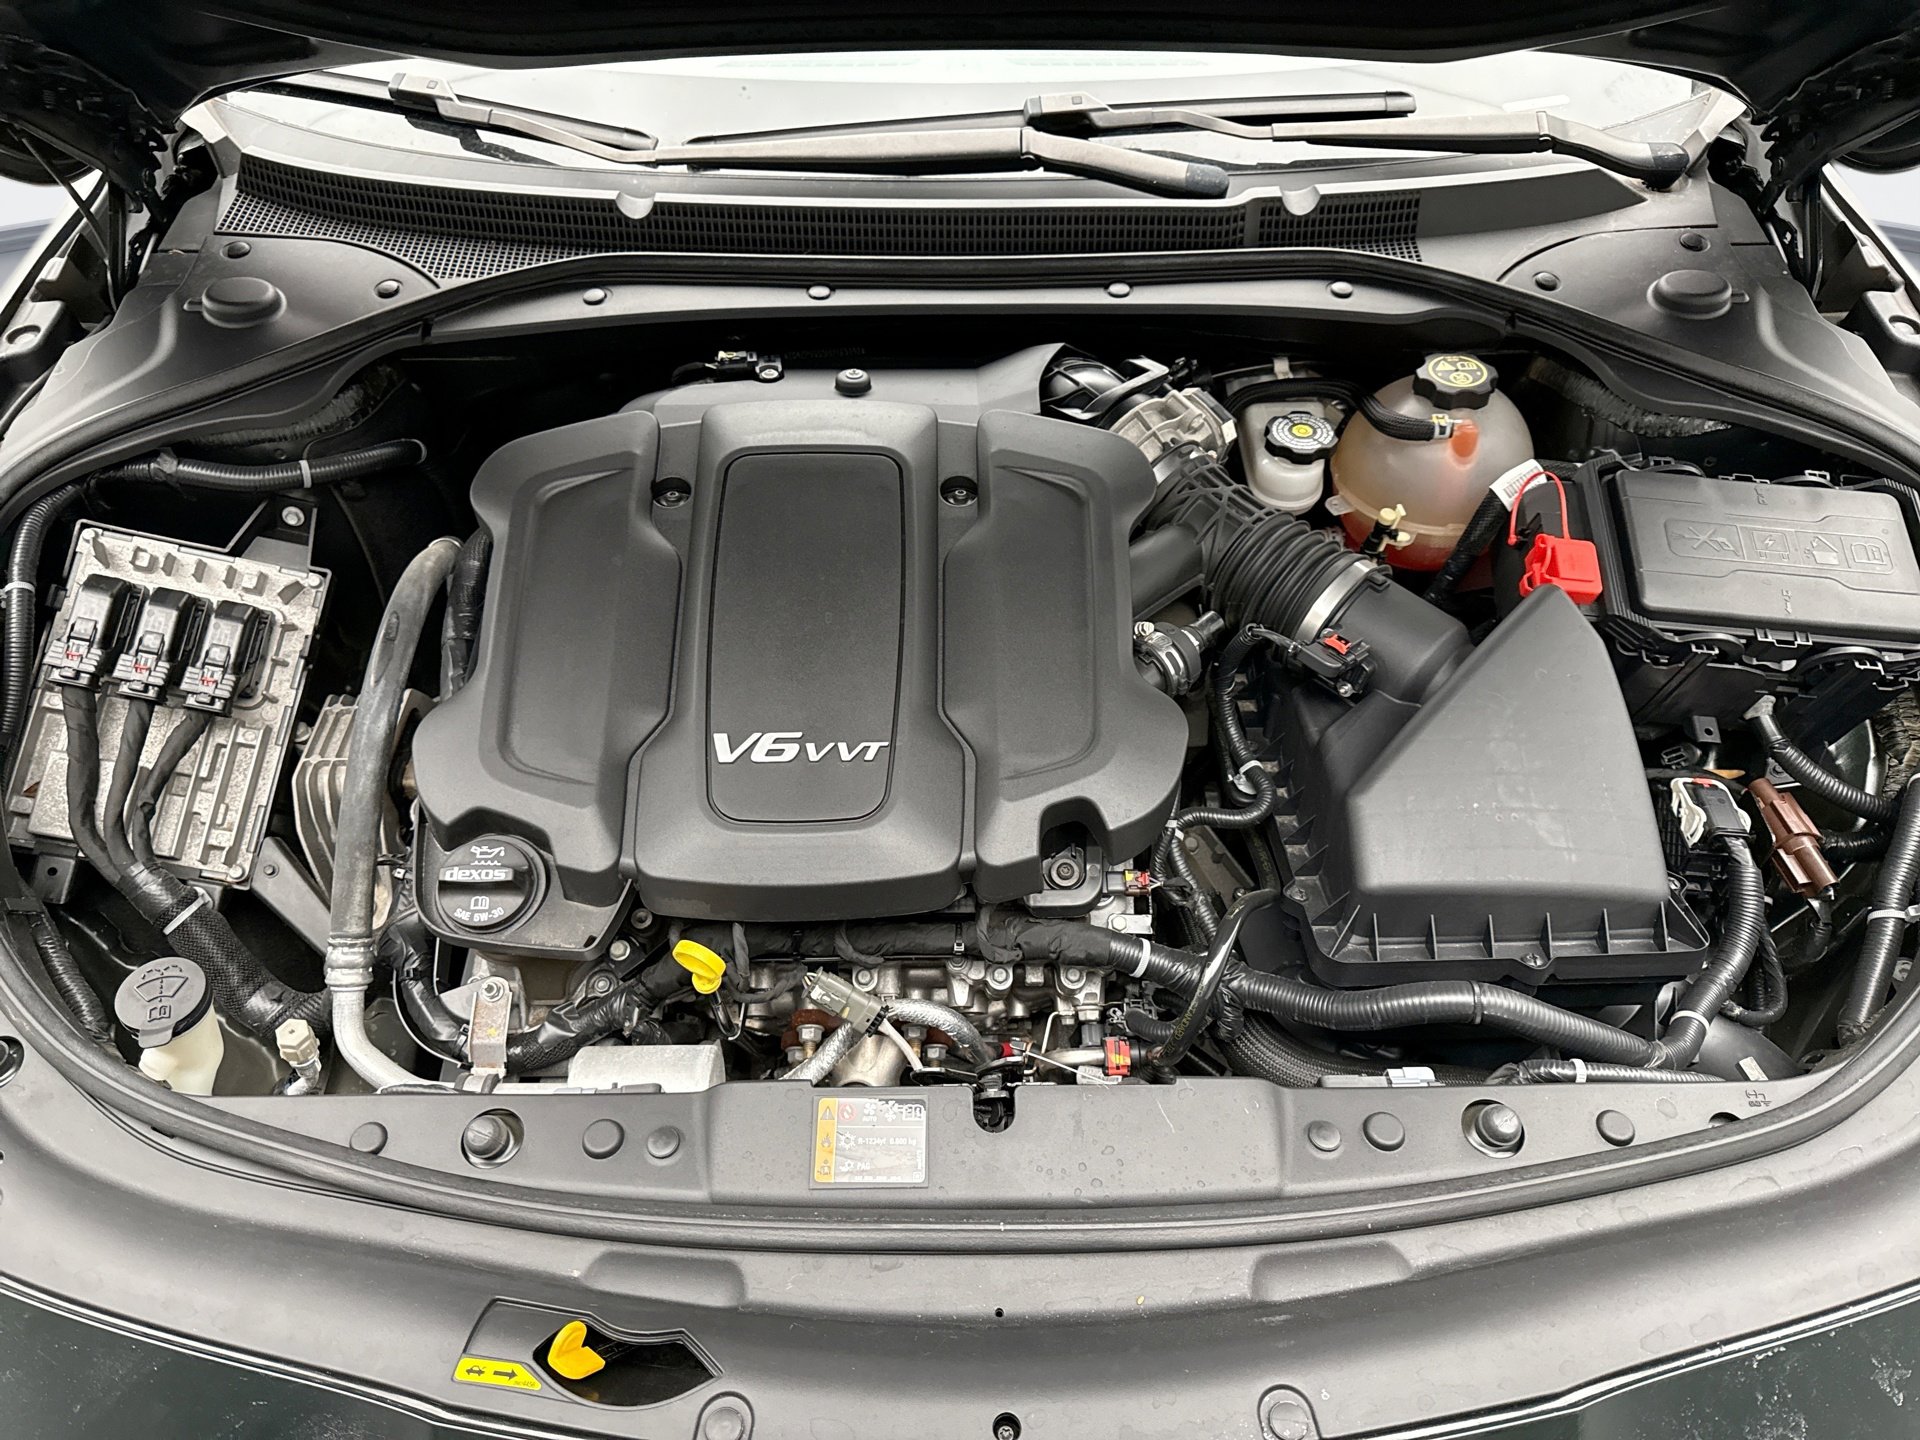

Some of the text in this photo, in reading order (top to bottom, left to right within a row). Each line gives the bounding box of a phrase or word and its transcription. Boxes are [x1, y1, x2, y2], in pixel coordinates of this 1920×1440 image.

[713, 731, 889, 763] V6 VVT
[444, 867, 508, 881] dexos
[453, 907, 504, 922] SAE 5W-30
